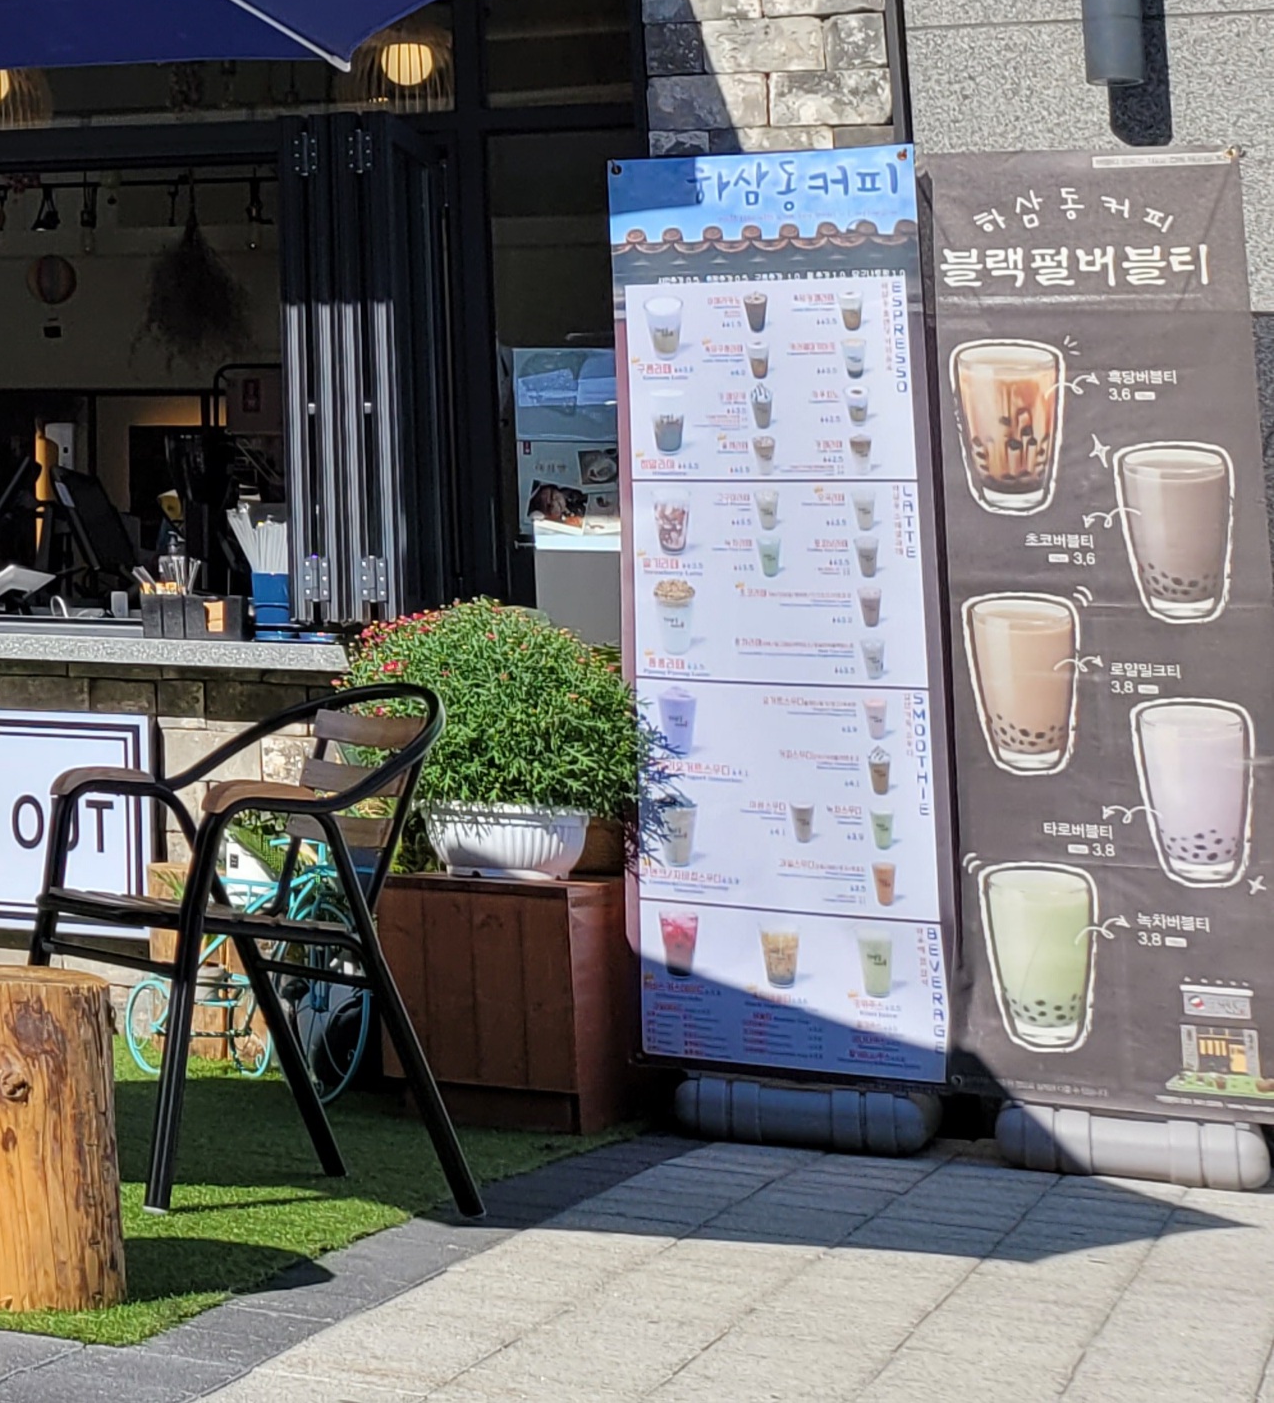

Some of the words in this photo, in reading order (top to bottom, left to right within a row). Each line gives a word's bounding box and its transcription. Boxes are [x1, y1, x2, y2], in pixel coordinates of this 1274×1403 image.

[940, 244, 1210, 288] 블랙펄버블티
[892, 281, 908, 393] ESPRESSO
[1109, 388, 1131, 401] 3.6
[902, 485, 917, 559] LATTE
[1025, 533, 1094, 549] 초코버블티
[1073, 552, 1095, 565] 3.6
[1110, 680, 1134, 695] 3.8
[913, 692, 930, 816] SMOOTHIE
[1043, 822, 1113, 838] 타로버블티
[1092, 844, 1115, 857] 3.8
[1137, 912, 1210, 932] 녹차버블티
[1138, 932, 1162, 947] 3.8
[926, 927, 946, 1055] BEVERAGE
